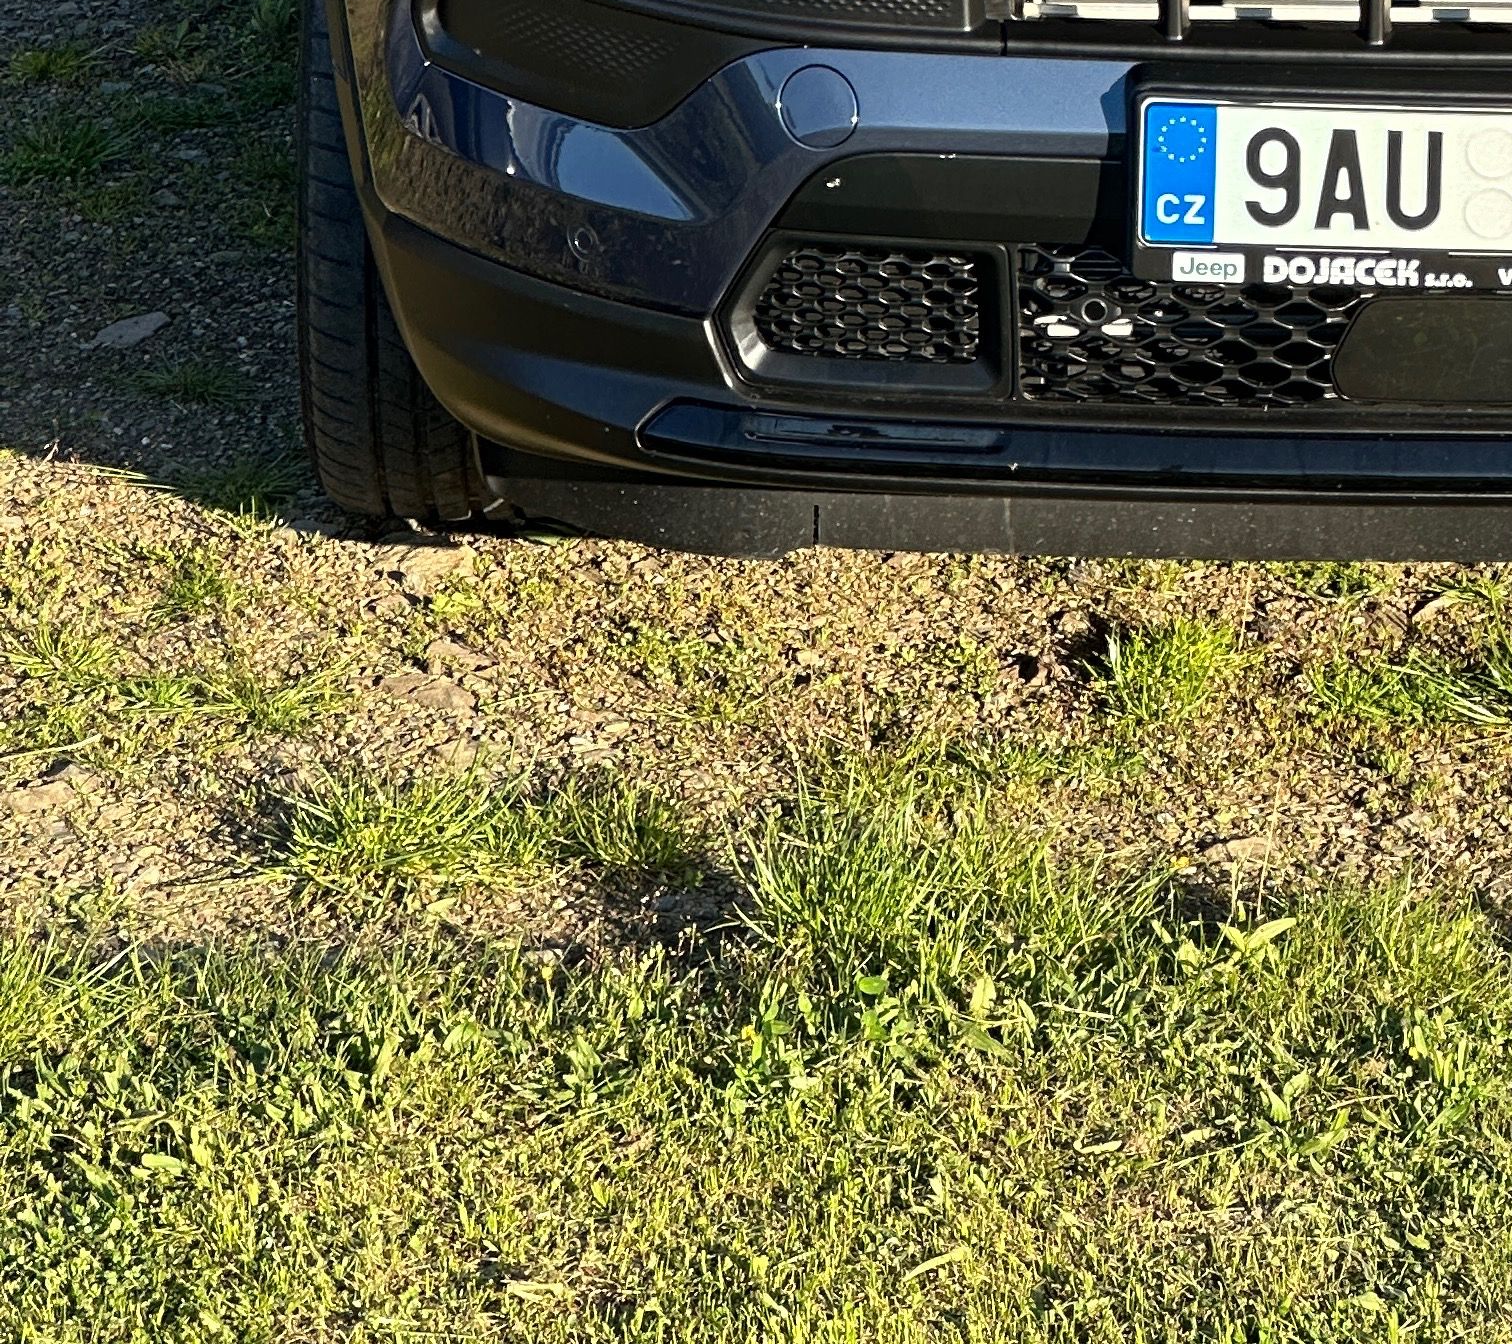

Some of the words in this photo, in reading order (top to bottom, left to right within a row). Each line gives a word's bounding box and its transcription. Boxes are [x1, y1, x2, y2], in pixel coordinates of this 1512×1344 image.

[1245, 127, 1443, 230] 9AU
[1156, 193, 1206, 225] CZ
[1179, 256, 1238, 281] Jeep
[1263, 256, 1420, 286] DOJACEK
[1424, 273, 1474, 289] s.r.o.
